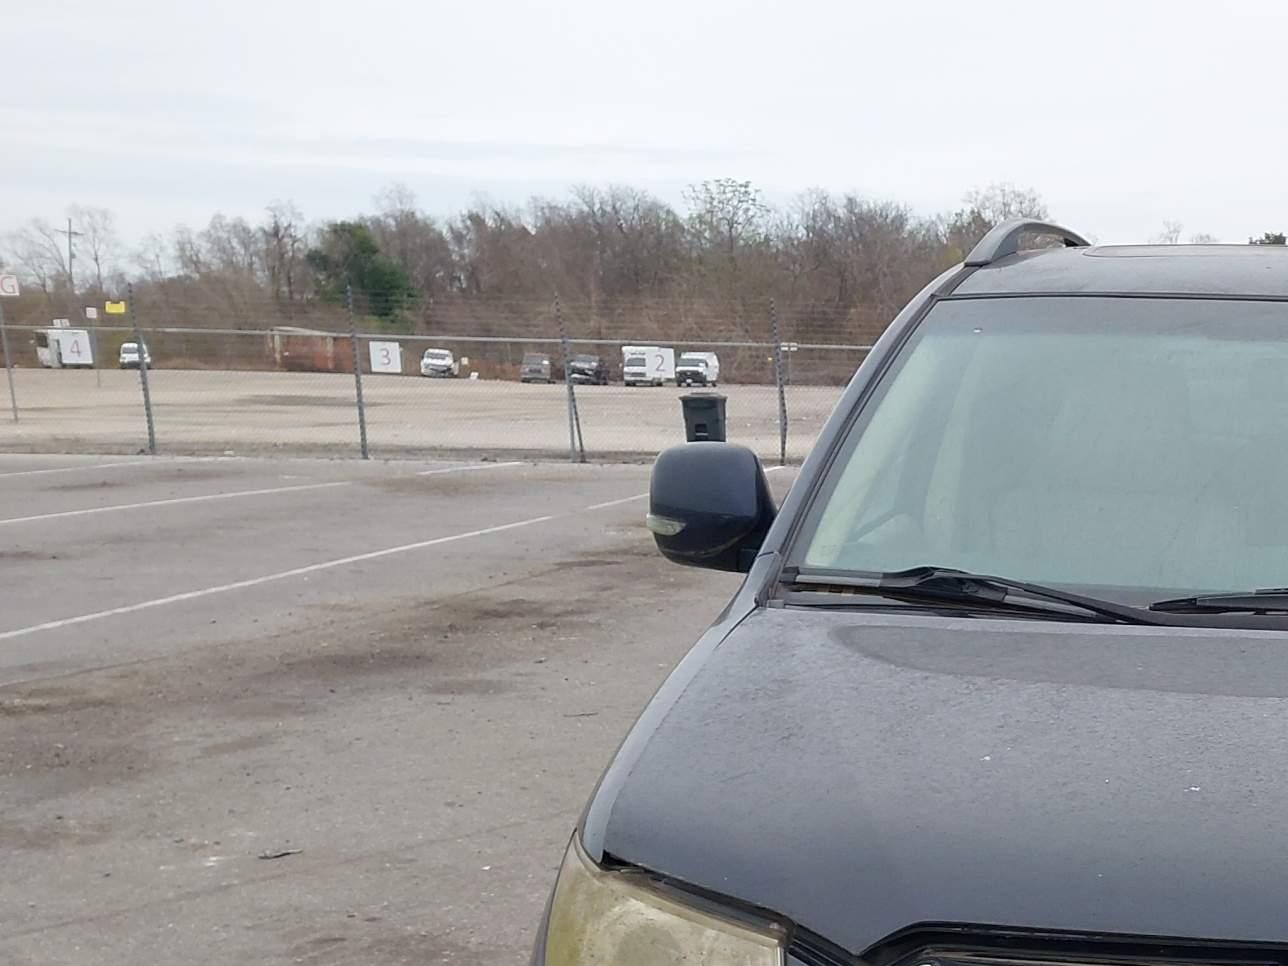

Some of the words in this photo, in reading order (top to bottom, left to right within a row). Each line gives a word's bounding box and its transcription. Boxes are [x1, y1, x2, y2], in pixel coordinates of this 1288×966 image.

[70, 339, 81, 358] 4
[379, 347, 391, 366] 3
[655, 354, 665, 372] 2
